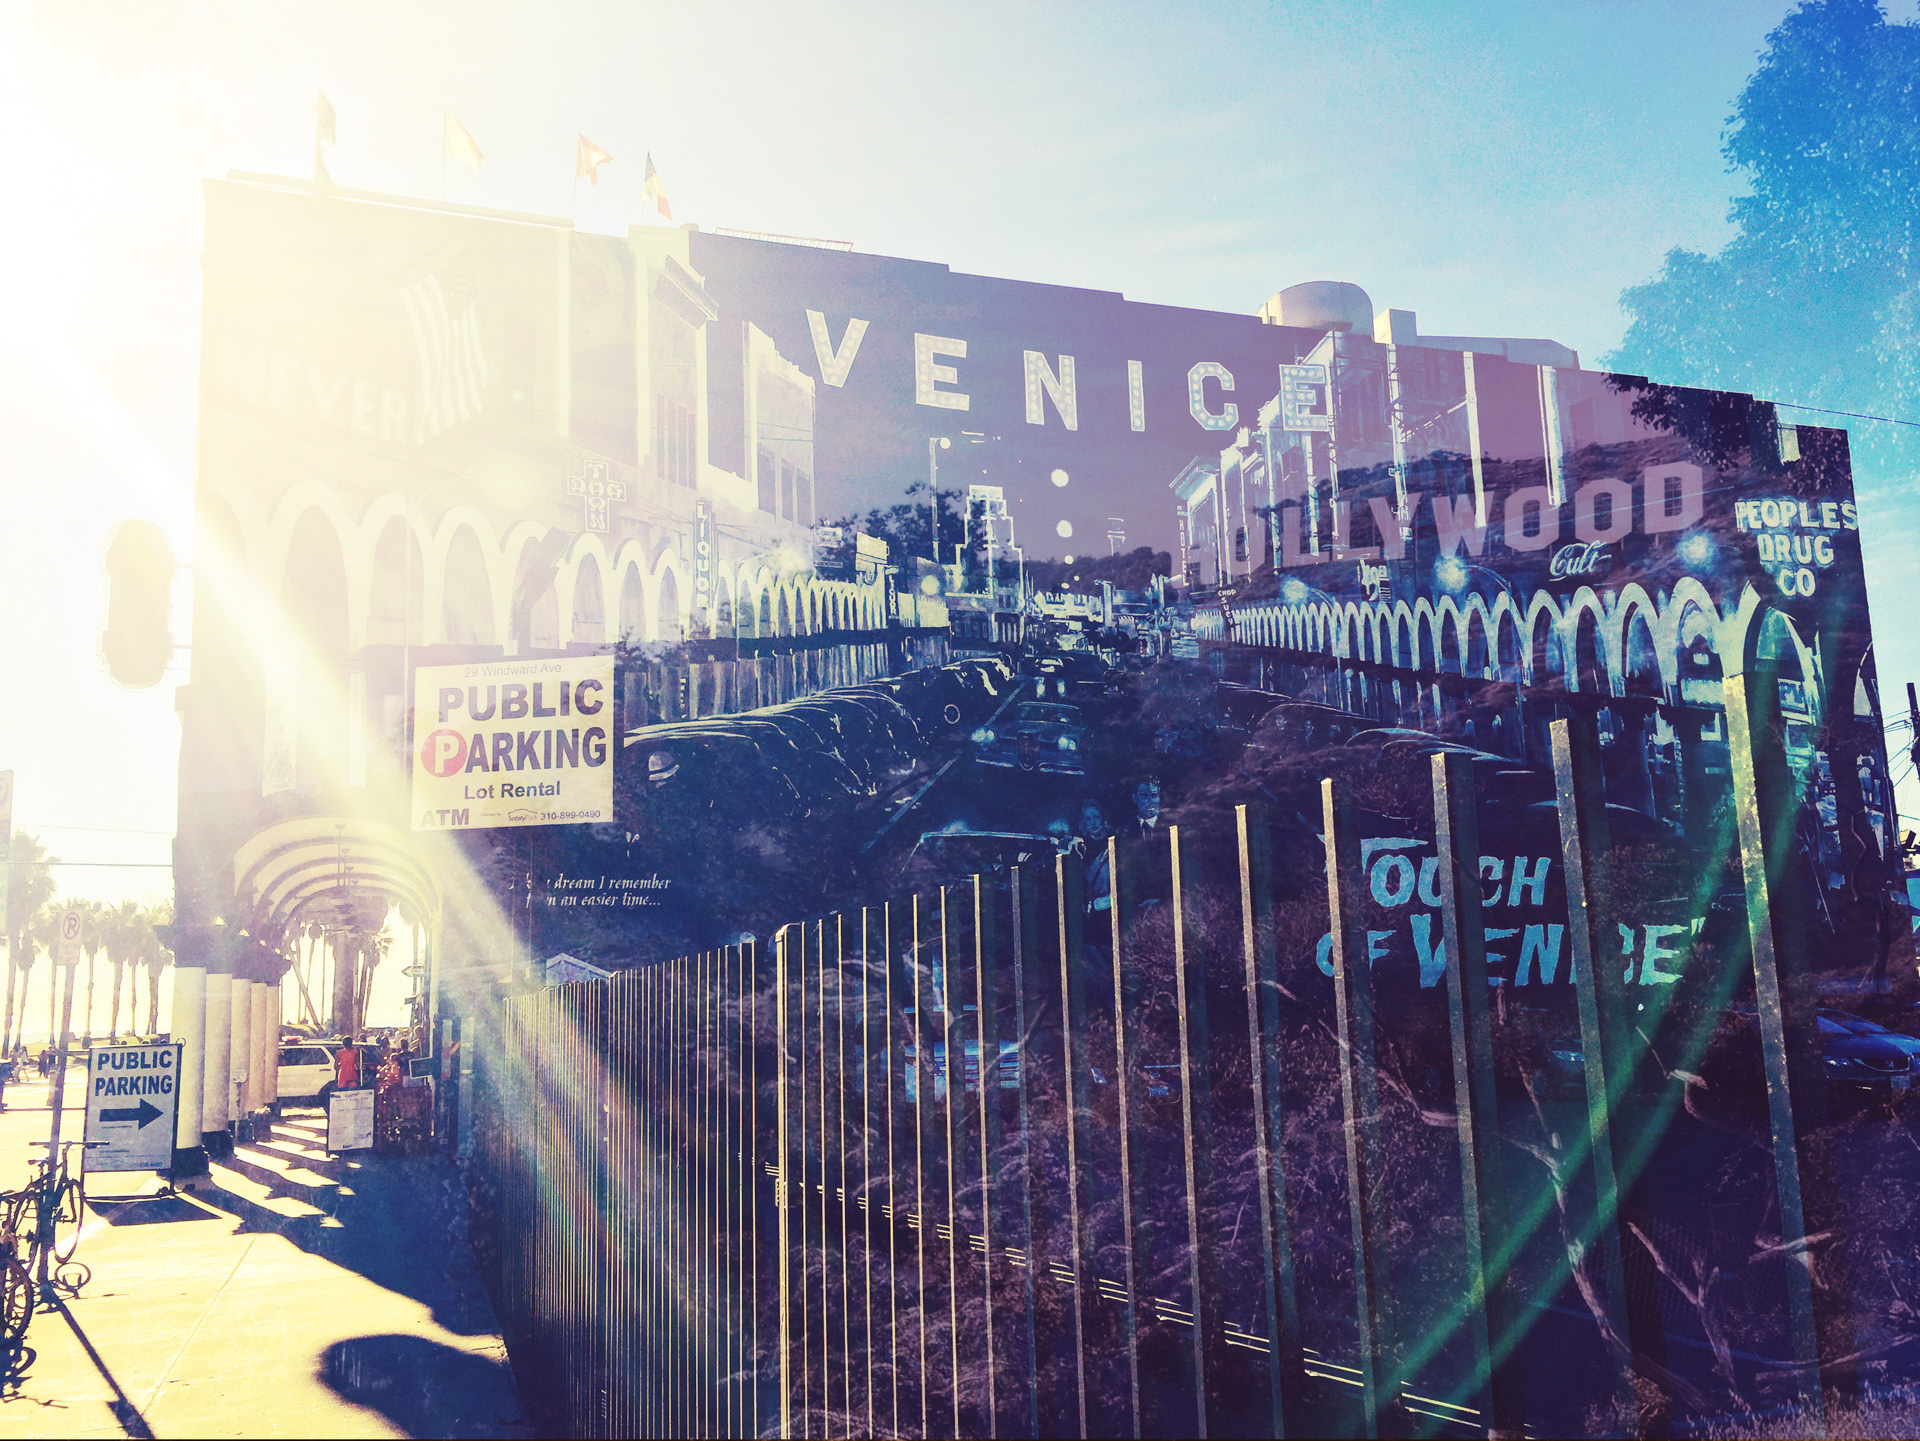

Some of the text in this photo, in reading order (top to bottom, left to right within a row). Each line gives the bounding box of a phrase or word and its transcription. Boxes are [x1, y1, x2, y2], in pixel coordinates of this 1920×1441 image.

[805, 308, 1330, 432] VENICE
[1171, 461, 1704, 589] HOLLYWOOD
[696, 501, 710, 608] LIQUOR
[1179, 519, 1190, 586] HOTEL
[1757, 533, 1834, 565] DRUG
[1779, 568, 1816, 598] CO
[464, 668, 478, 678] 29
[482, 664, 537, 677] Windward
[438, 679, 604, 723] PUBLIC
[434, 727, 607, 774] PARKING
[464, 781, 560, 800] Lot Rental
[421, 809, 470, 827] ATM
[554, 873, 595, 889] dream
[608, 873, 672, 889] remember
[560, 896, 577, 907] an
[581, 892, 618, 906] easier
[97, 1050, 173, 1071] PUBLIC
[94, 1074, 173, 1097] PARKING
